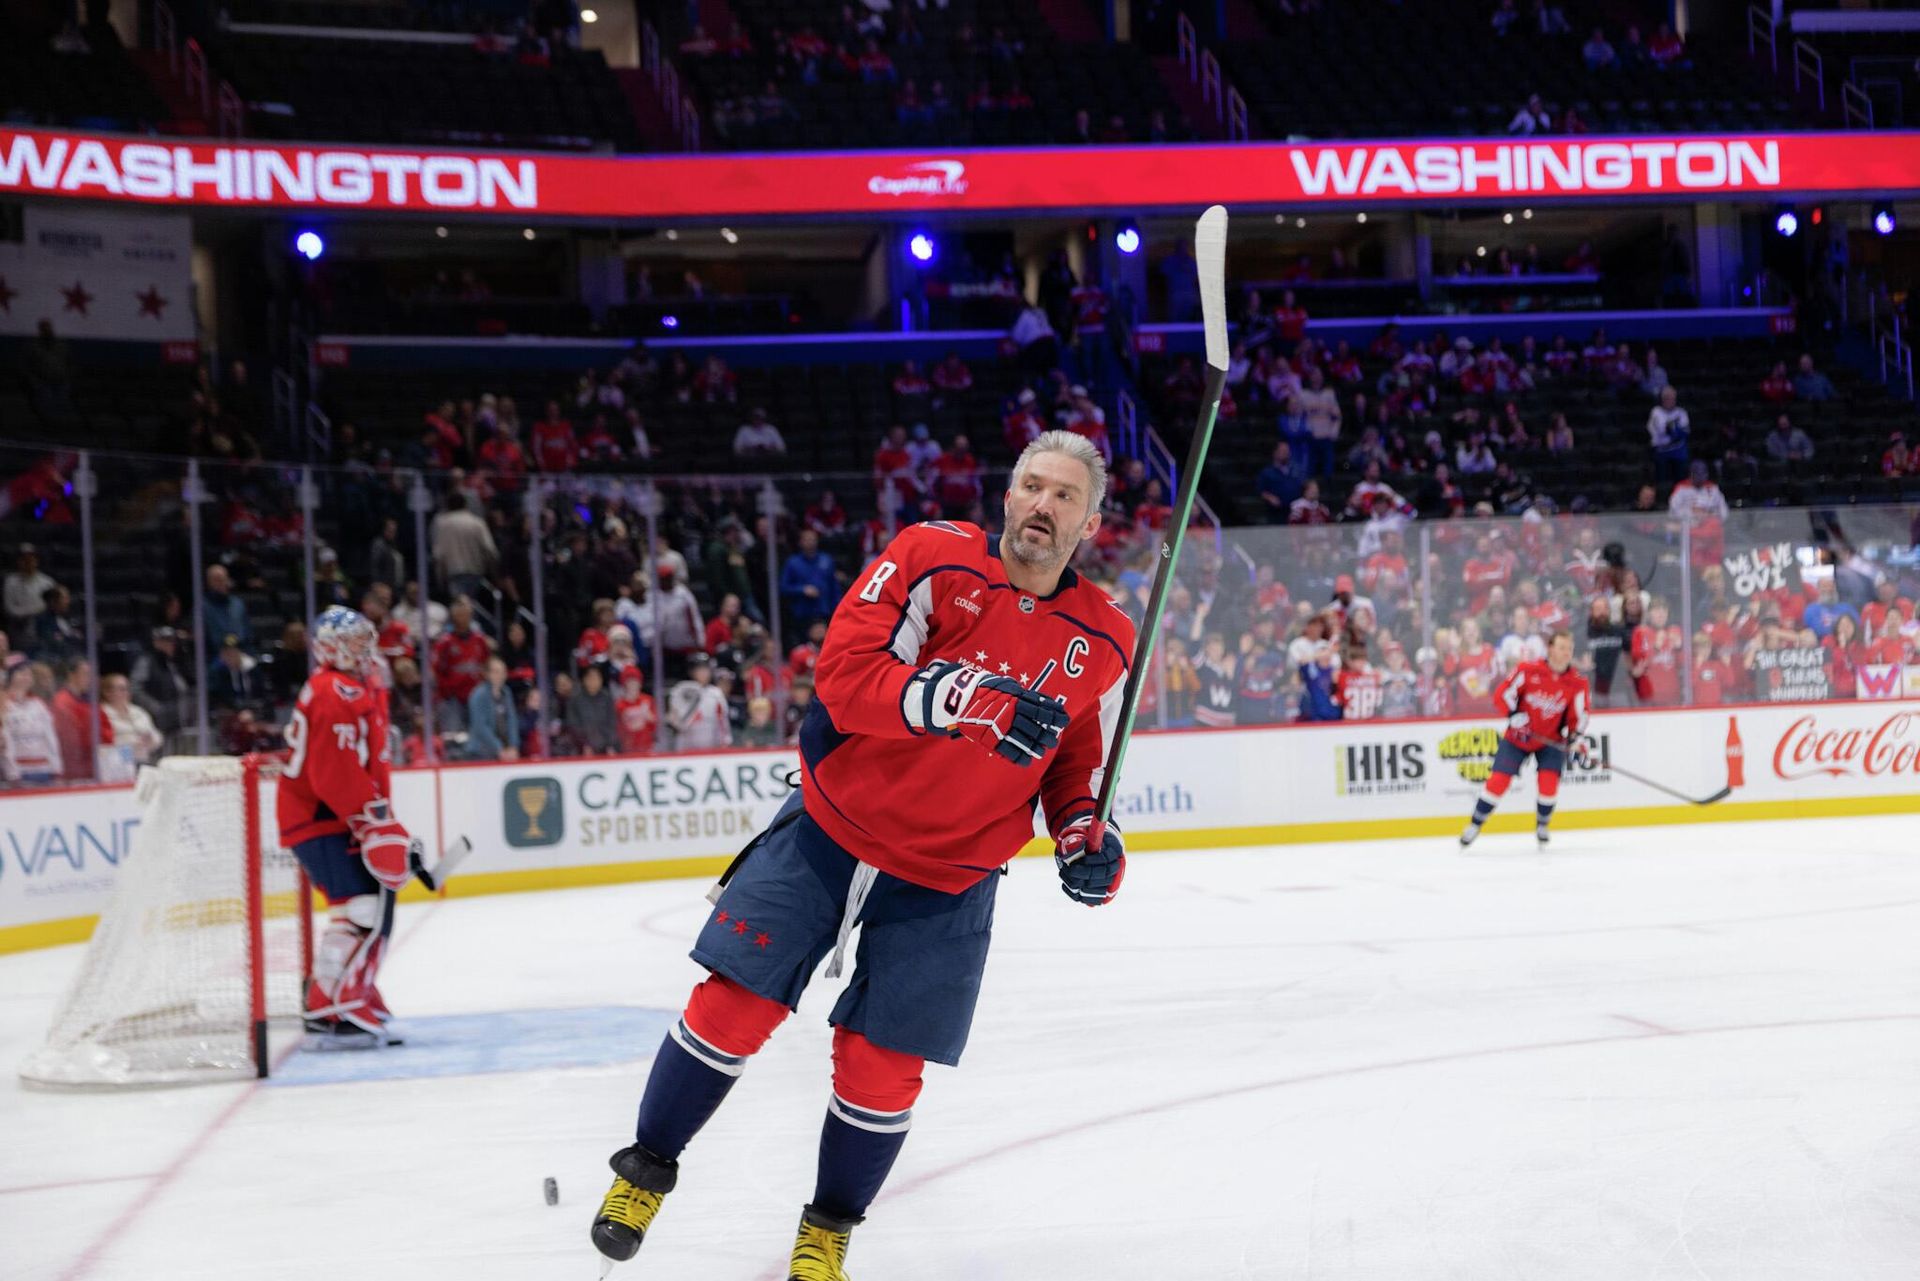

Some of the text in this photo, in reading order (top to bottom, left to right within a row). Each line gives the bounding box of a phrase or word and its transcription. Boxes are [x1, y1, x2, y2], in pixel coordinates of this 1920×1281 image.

[0, 135, 538, 208] WASHINGTON
[1290, 141, 1780, 196] WASHINGTON
[859, 560, 898, 603] 8
[1734, 567, 1787, 597] OVI
[1063, 635, 1090, 679] C
[943, 667, 977, 717] CC
[1857, 661, 1903, 699] W
[1347, 743, 1425, 782] HHS
[1438, 727, 1499, 759] HERCUL
[577, 763, 791, 811] CAESARS
[1113, 784, 1193, 814] ealth
[579, 808, 756, 846] SPORTSBOOK
